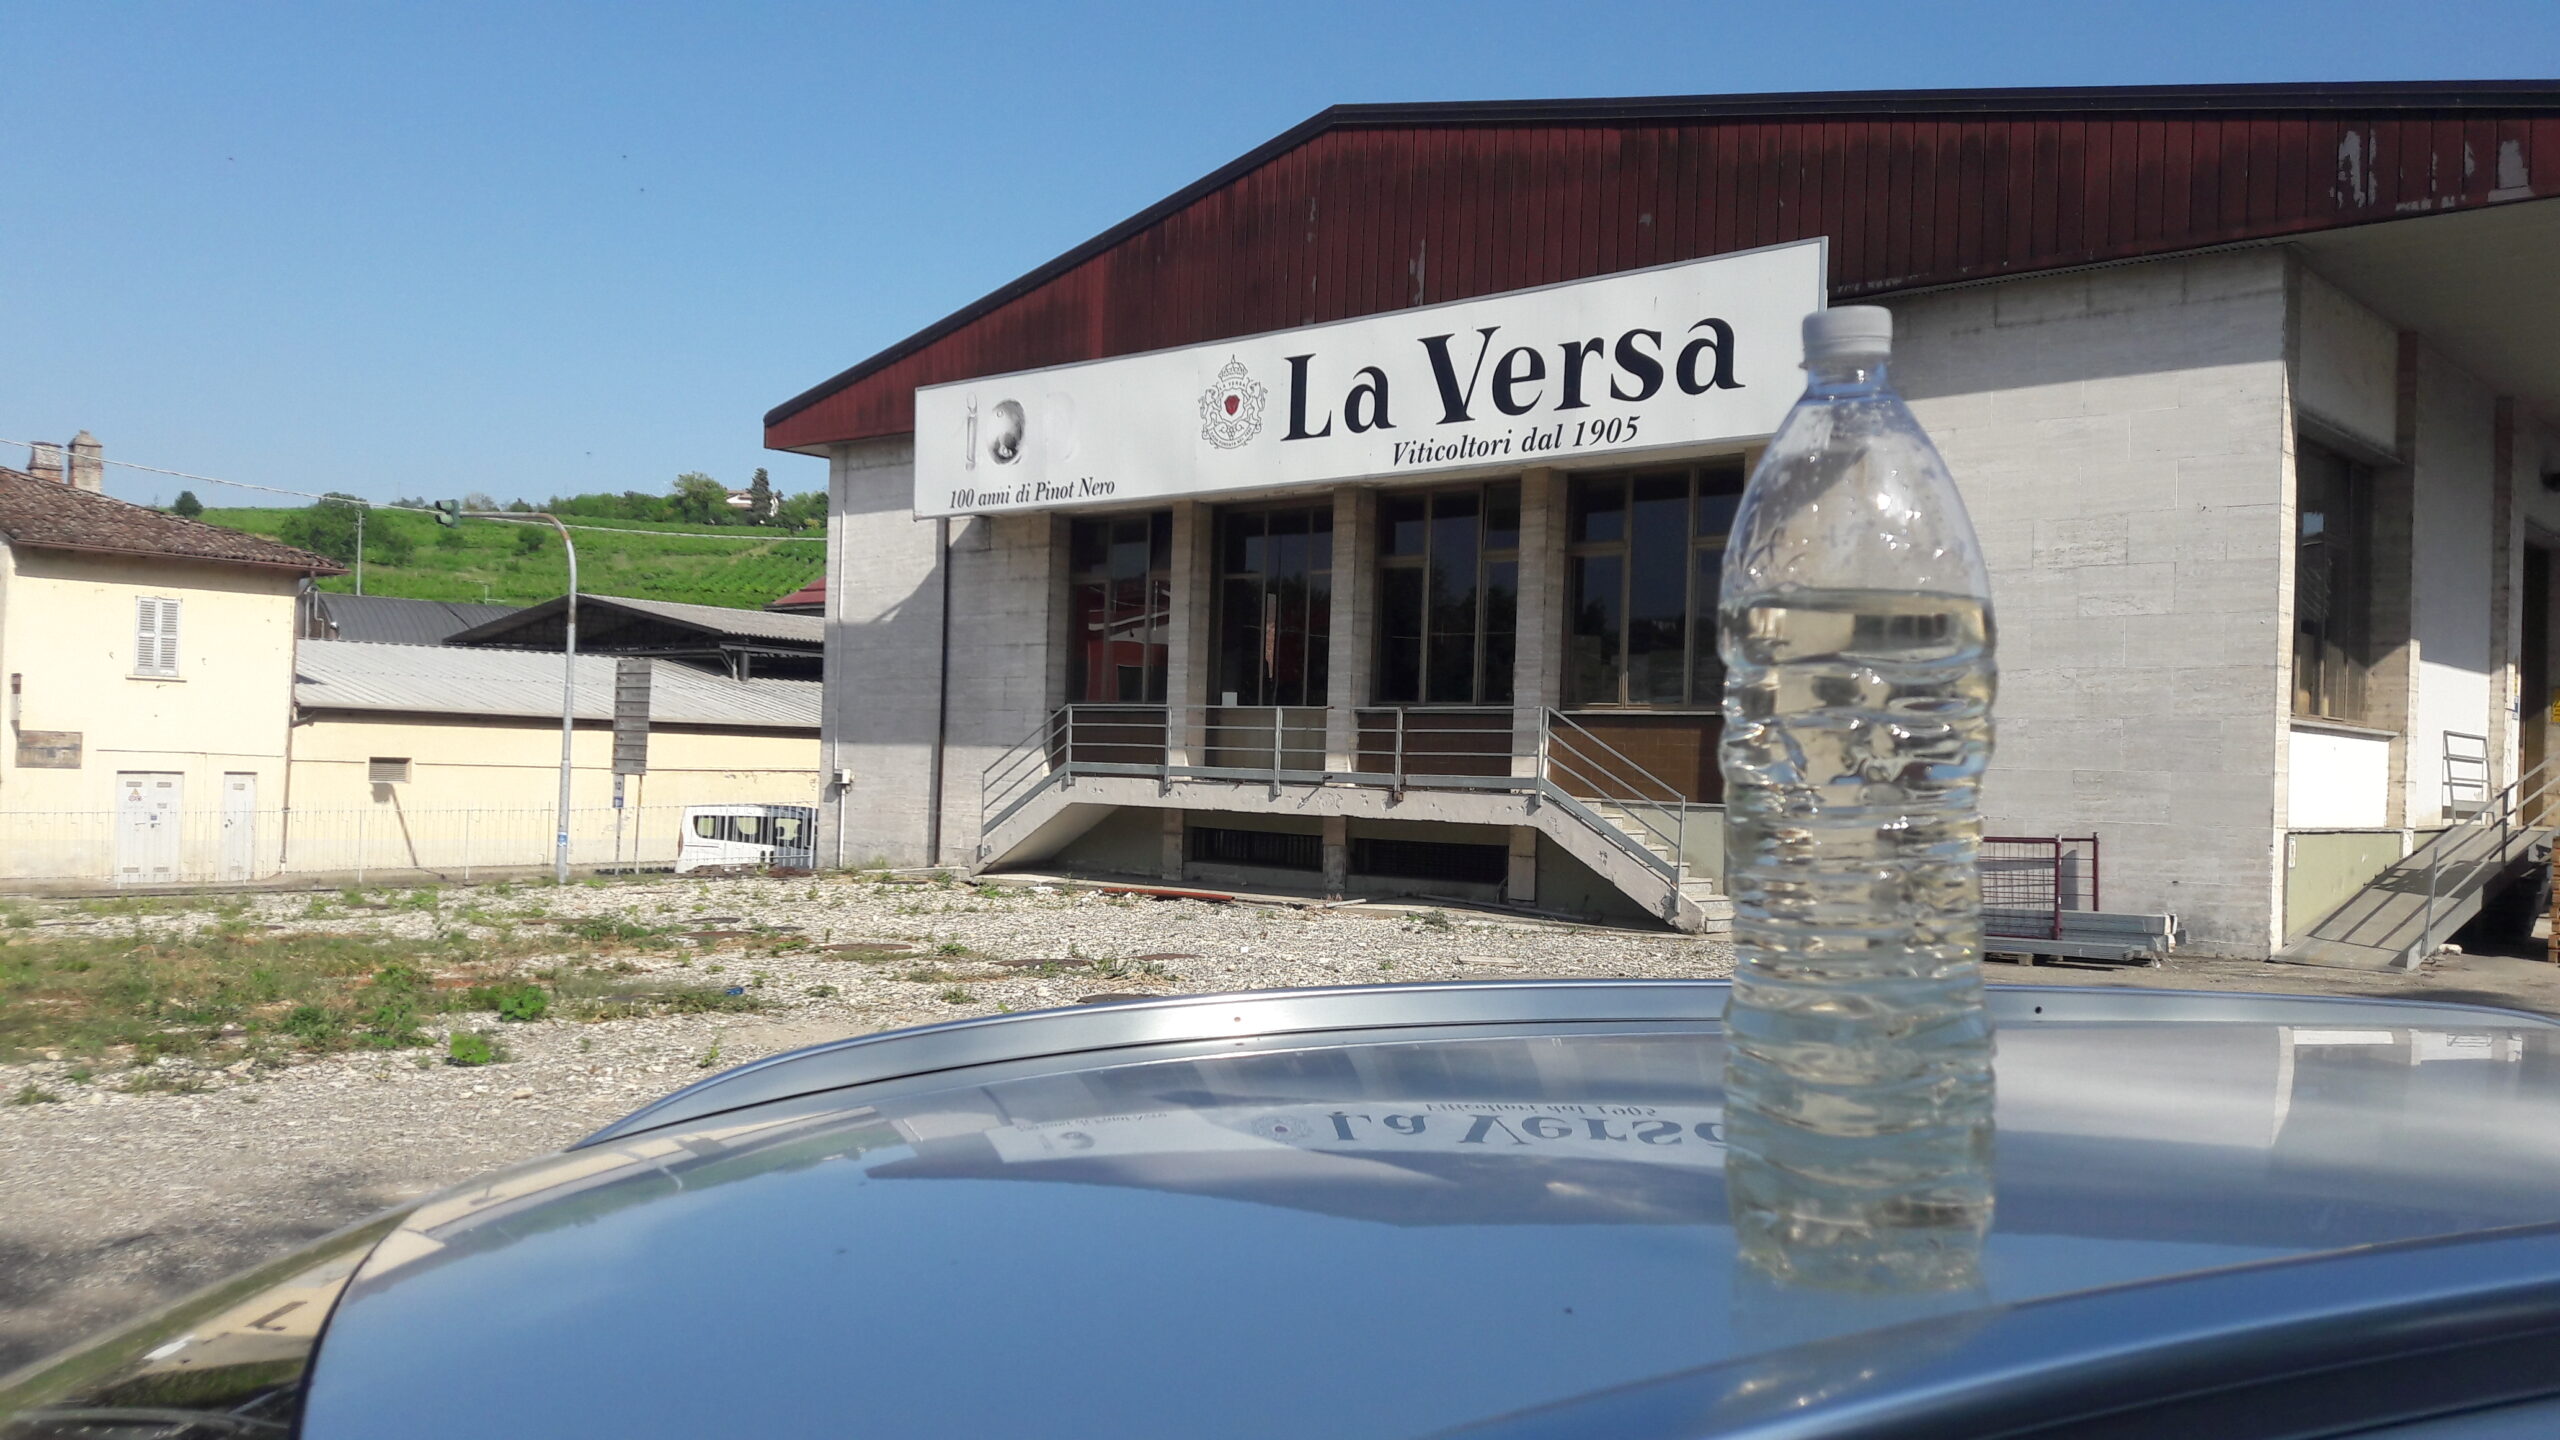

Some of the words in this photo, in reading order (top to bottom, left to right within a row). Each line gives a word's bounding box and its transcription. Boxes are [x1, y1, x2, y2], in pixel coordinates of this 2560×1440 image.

[1280, 353, 1397, 442] La
[1417, 317, 1746, 426] Versa
[1393, 429, 1513, 466] Viticoltori
[1521, 424, 1563, 452] dal
[1572, 416, 1641, 448] 1905
[949, 488, 975, 509] 100
[978, 485, 1011, 507] anni
[1016, 481, 1030, 504] di
[1034, 480, 1075, 502] Pinot
[1078, 476, 1115, 497] Nero
